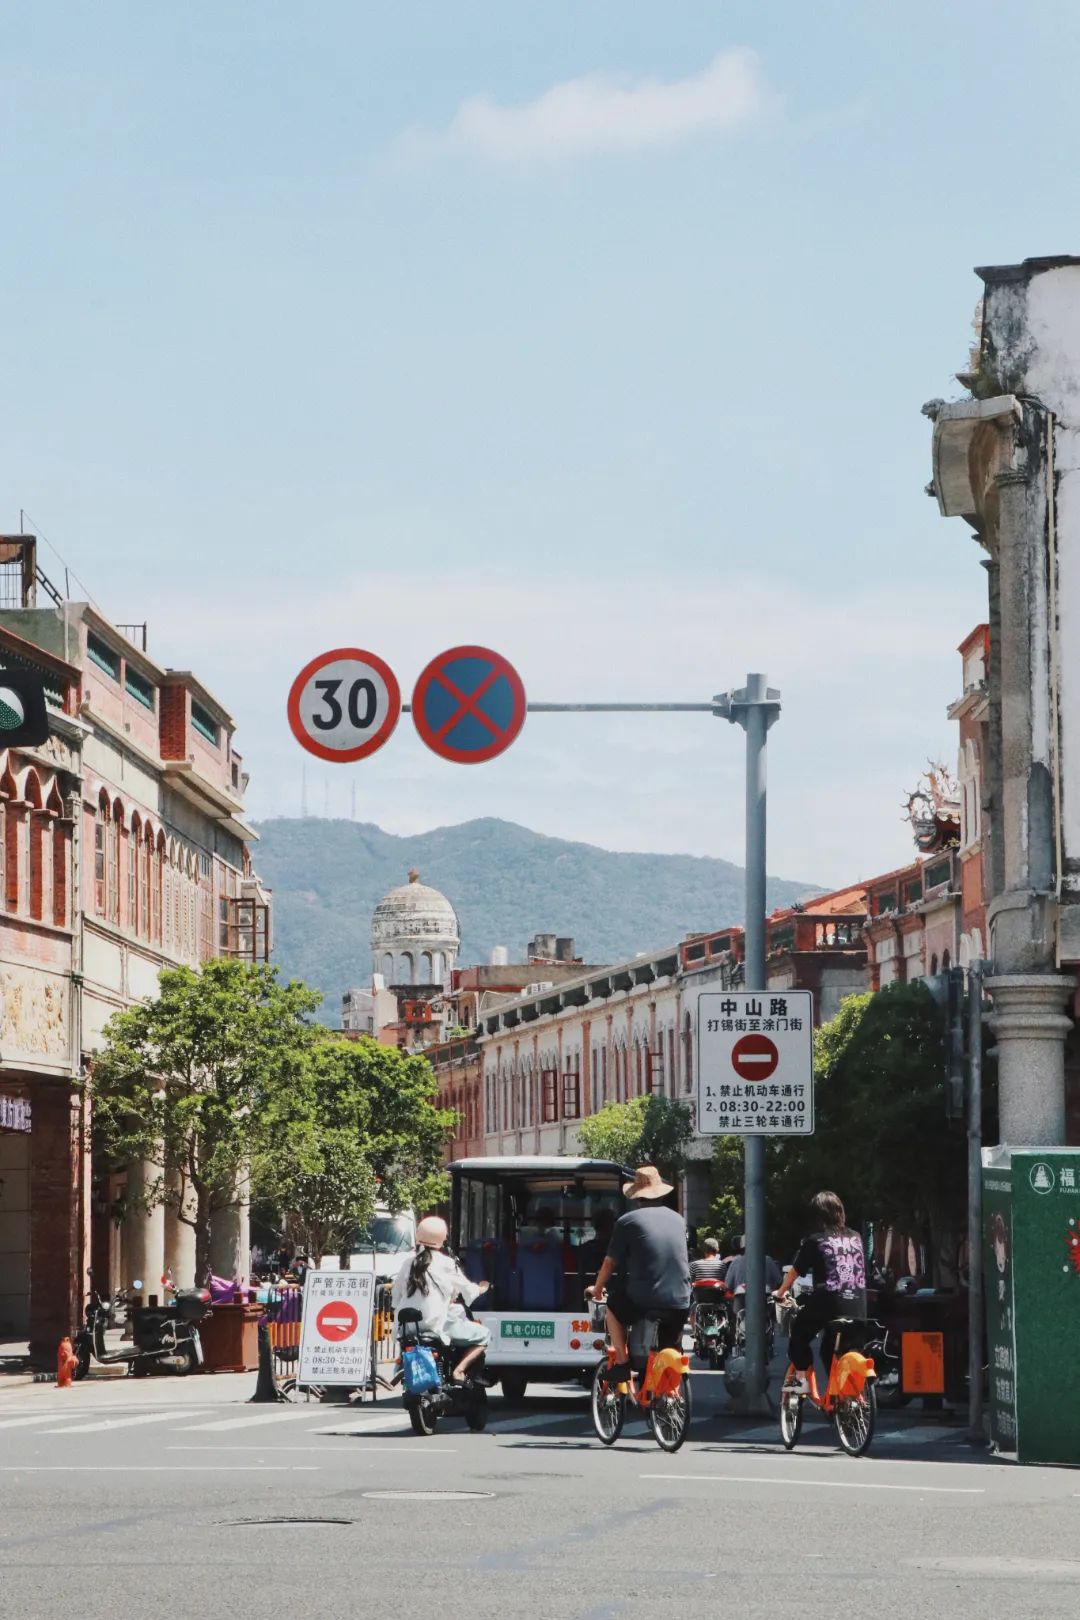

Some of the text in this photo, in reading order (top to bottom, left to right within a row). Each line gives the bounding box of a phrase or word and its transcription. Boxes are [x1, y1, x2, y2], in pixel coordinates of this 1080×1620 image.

[312, 678, 377, 730] 30
[720, 998, 788, 1017] 中山路
[707, 1018, 802, 1032] 打锡街至涂门街
[719, 1115, 805, 1128] 禁止三轮车通行
[311, 1277, 369, 1289] 严管示范街
